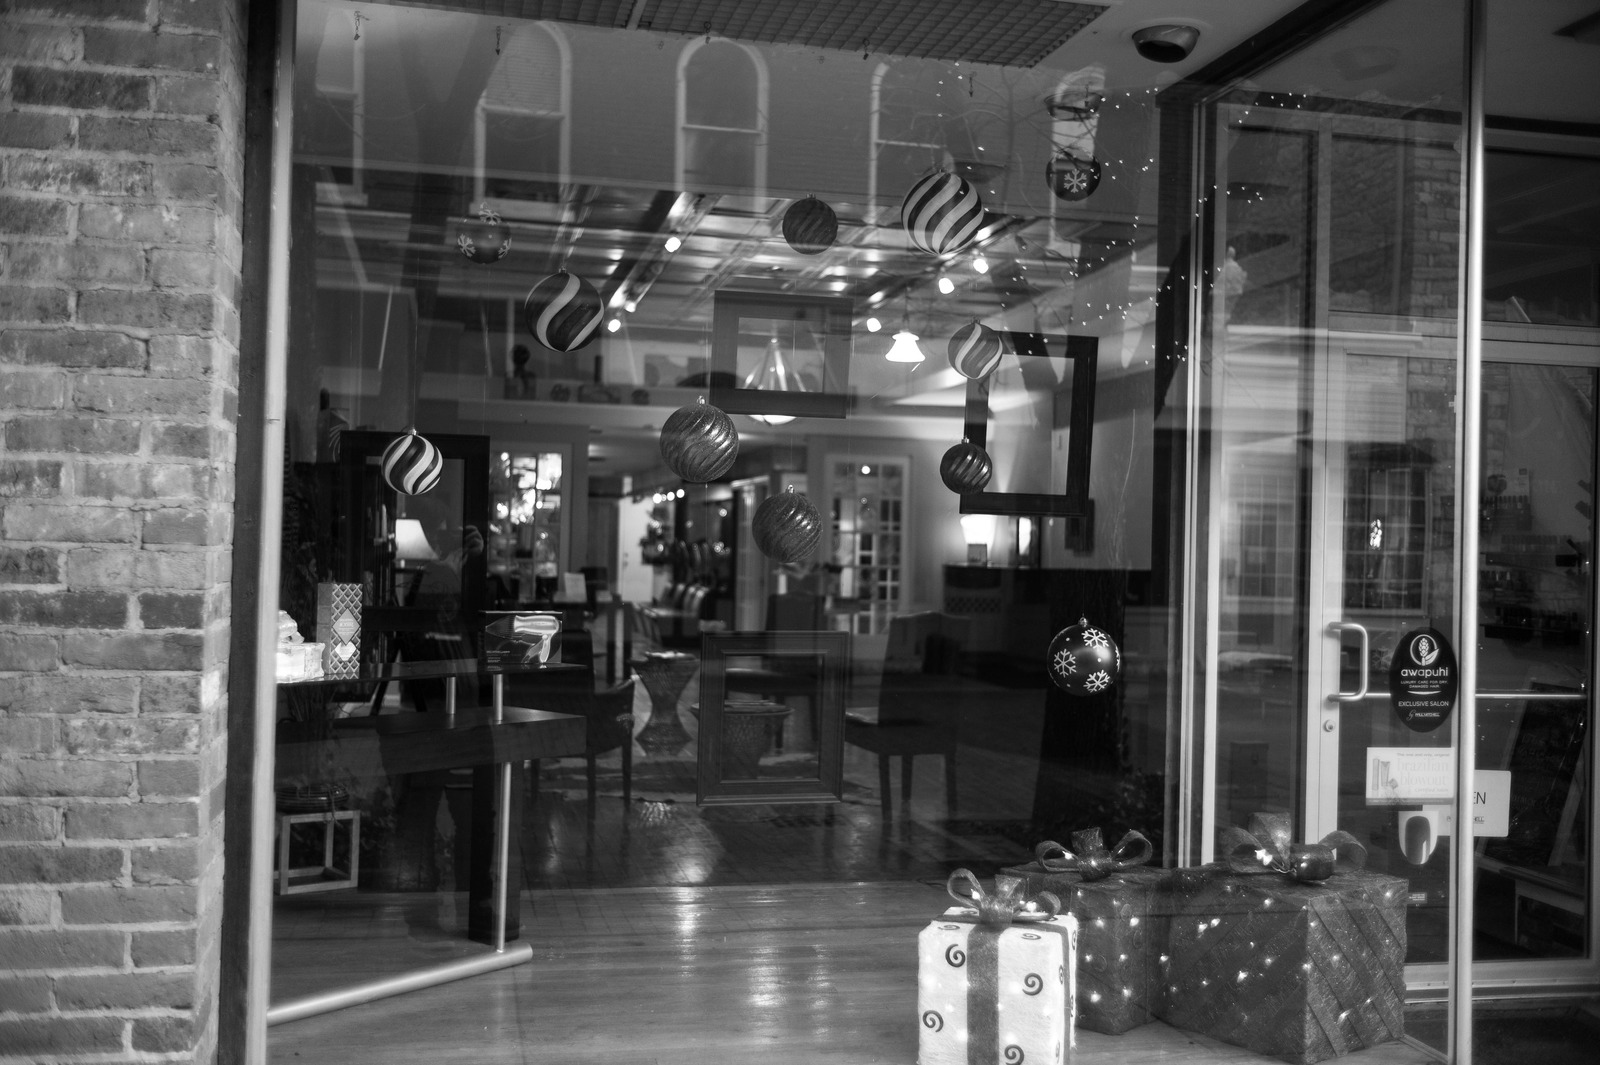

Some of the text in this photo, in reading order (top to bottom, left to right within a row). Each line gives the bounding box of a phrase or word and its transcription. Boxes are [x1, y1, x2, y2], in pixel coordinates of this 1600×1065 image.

[1400, 667, 1448, 678] awapuhi
[1397, 758, 1449, 772] brazilian
[1400, 772, 1447, 786] blowout
